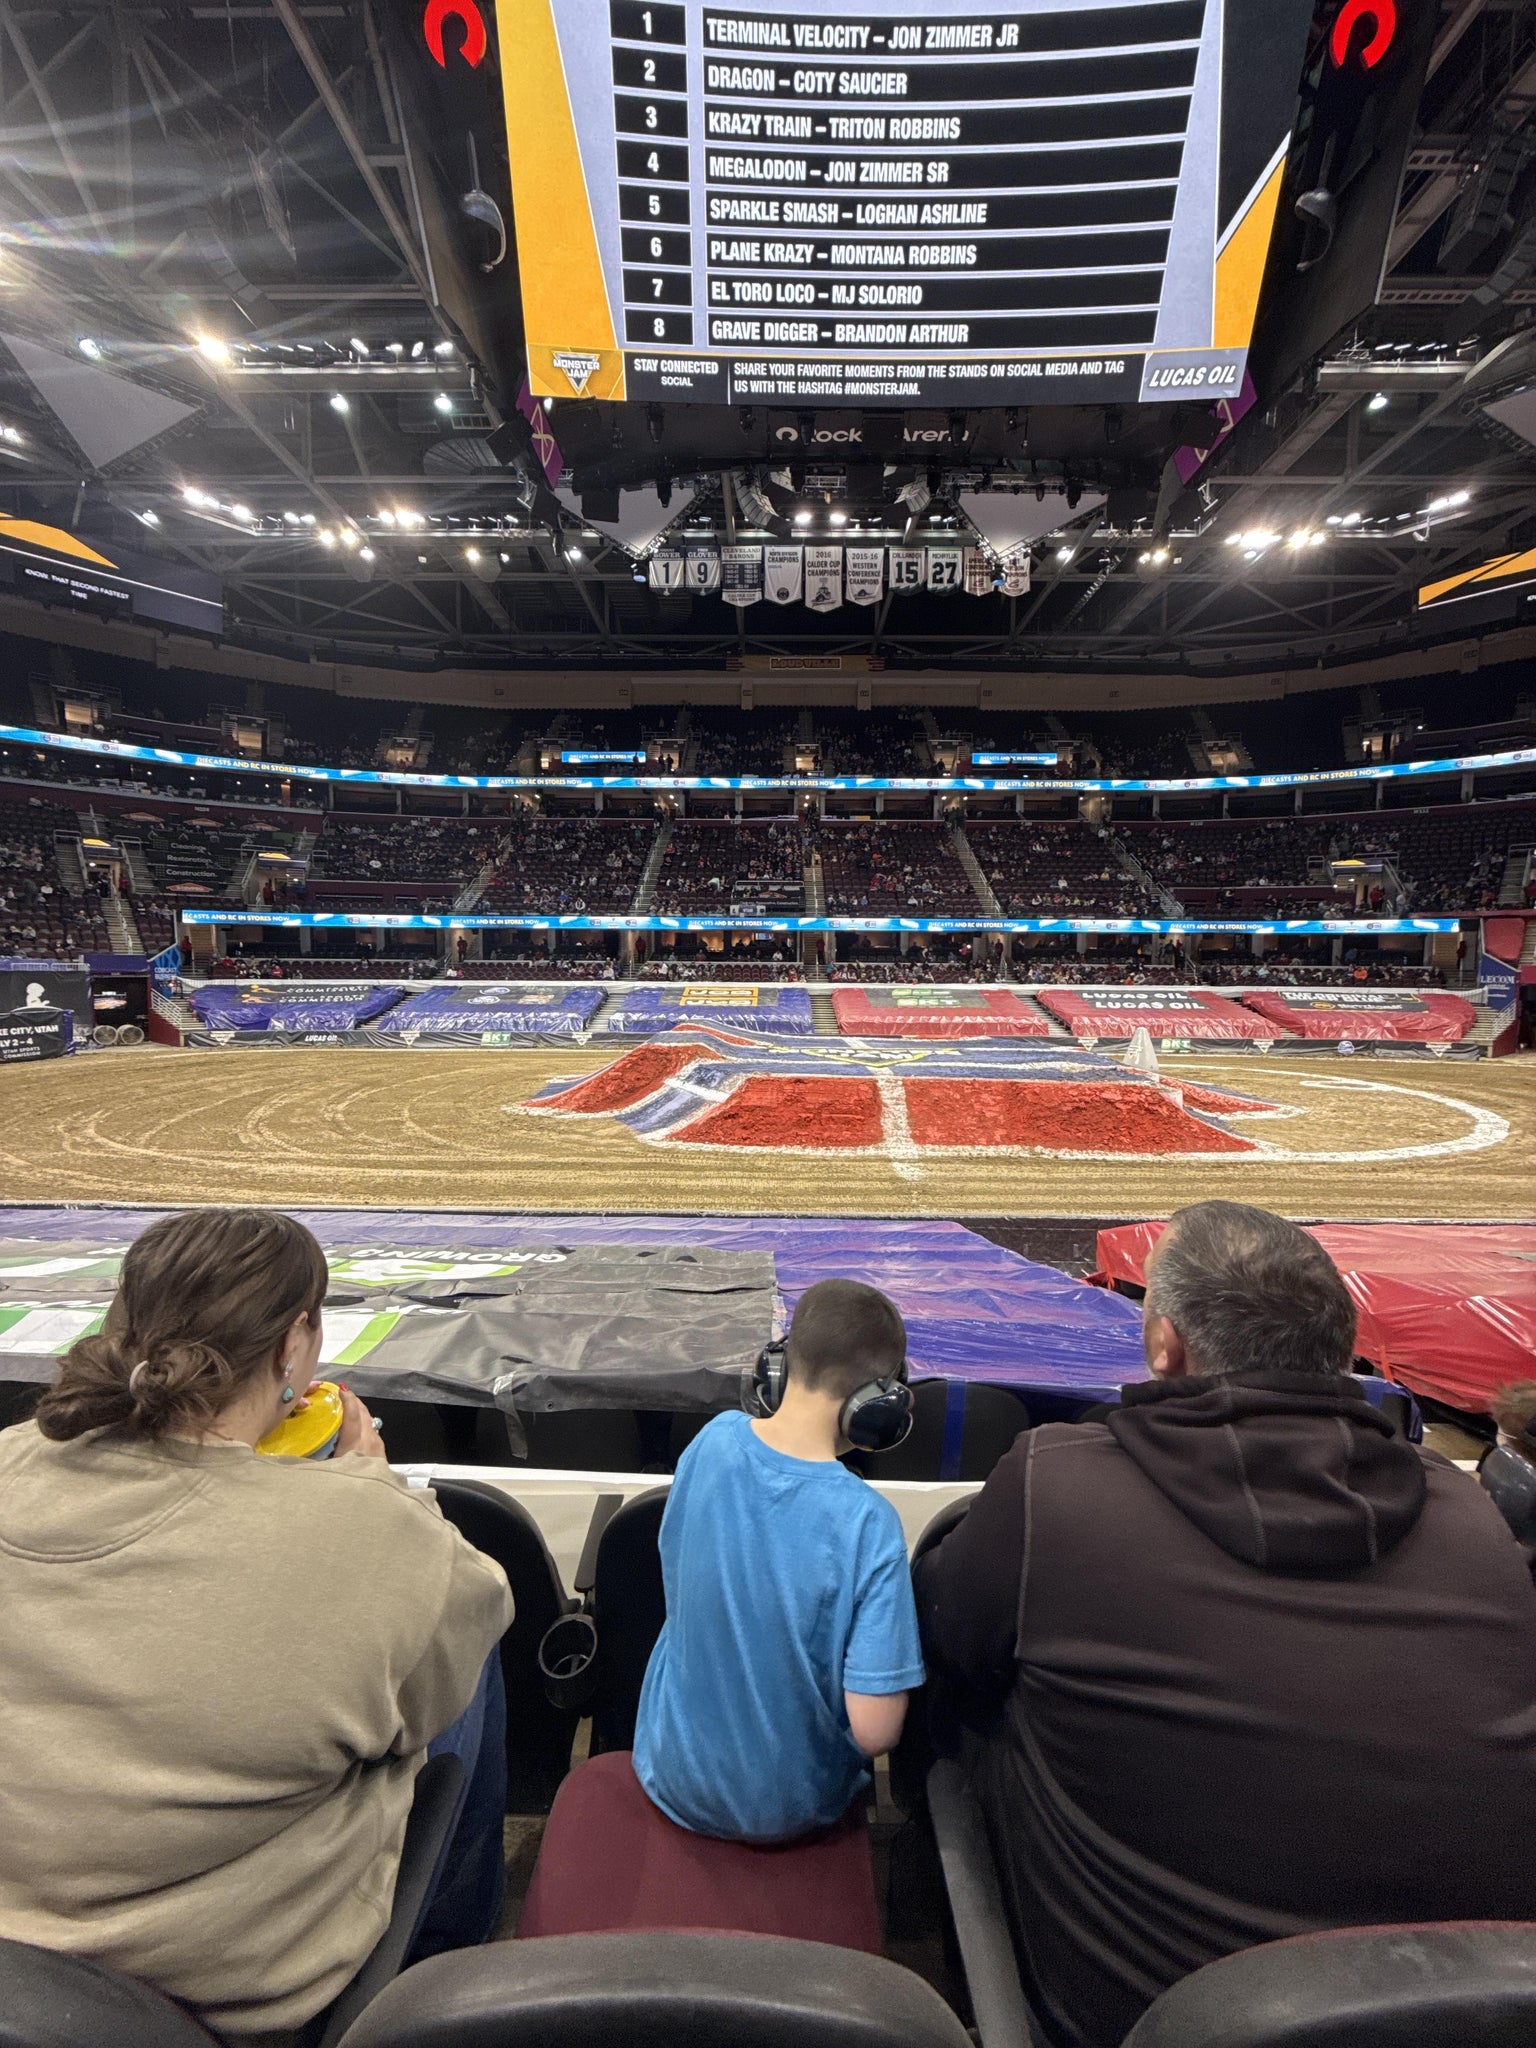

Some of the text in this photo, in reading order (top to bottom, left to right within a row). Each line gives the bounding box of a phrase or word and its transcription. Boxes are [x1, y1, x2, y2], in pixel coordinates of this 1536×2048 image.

[642, 11, 652, 35] 1
[707, 18, 790, 47] TERMINAL
[793, 24, 870, 48] VELOCITY
[888, 26, 921, 49] JON
[925, 25, 992, 48] ZIMMER
[996, 24, 1019, 47] JR
[644, 60, 656, 82] 2
[708, 65, 775, 91] DRAGON
[794, 71, 836, 93] COTY
[839, 72, 907, 95] SAUCIER
[645, 106, 657, 128] 3
[709, 111, 761, 135] KRAZY
[764, 115, 811, 137] TRAIN
[829, 117, 885, 139] TRITON
[890, 117, 960, 139] ROBBINS
[647, 152, 659, 173] 4
[709, 156, 806, 181] MEGALODON
[824, 161, 856, 182] JON
[859, 162, 923, 183] ZIMMER
[927, 162, 949, 183] SR
[649, 195, 661, 215] 5
[710, 199, 779, 221] SPARKLE
[783, 202, 839, 223] SMASH
[857, 204, 918, 224] LOGHAN
[920, 203, 987, 223] ASHLINE
[650, 237, 662, 257] 6
[710, 240, 760, 261] PLANE
[764, 243, 814, 263] KRAZY
[831, 245, 905, 264] MONTANA
[909, 245, 977, 265] ROBBINS
[652, 278, 663, 297] 7
[711, 281, 730, 301] EL
[732, 283, 772, 302] TORO
[776, 284, 815, 303] LOCO
[832, 285, 855, 304] MJ
[859, 285, 923, 304] SOLORIO
[653, 318, 665, 337] 8
[712, 320, 760, 340] GRAVE
[764, 322, 818, 341] DIGGER
[835, 324, 906, 343] BRANDON
[909, 324, 969, 343] ARTHUR
[553, 359, 600, 370] MONSTER
[567, 369, 589, 379] JAM
[634, 359, 719, 374] STAY CONNECTED
[734, 361, 1124, 378] SHARE YOUR FAVORITE MOMENTS FROM THE STANDS ON SOCIAL MEDIA AND TAG
[661, 376, 693, 387] SOCIAL
[1149, 364, 1236, 388] LUCAS OIL
[734, 380, 921, 395] US WITH THE HASHTAG #MONSTERJAM.
[662, 562, 669, 584] 1
[697, 562, 708, 584] 9
[895, 561, 919, 584] 15
[932, 561, 957, 584] 27
[70, 579, 99, 593] SECOND
[100, 587, 129, 600] FASTEST
[233, 759, 249, 769] AND
[261, 762, 270, 771] IN
[271, 763, 296, 774] STORES
[1293, 774, 1309, 782] AND
[1331, 770, 1358, 779] STORES
[1480, 975, 1515, 984] LECOM
[1095, 1001, 1164, 1009] LUCAS
[10, 1026, 34, 1035] CITY,
[34, 1024, 59, 1034] UTAH
[12, 1038, 19, 1046] 2
[26, 1037, 34, 1045] 4
[348, 1248, 567, 1263] GROWING
